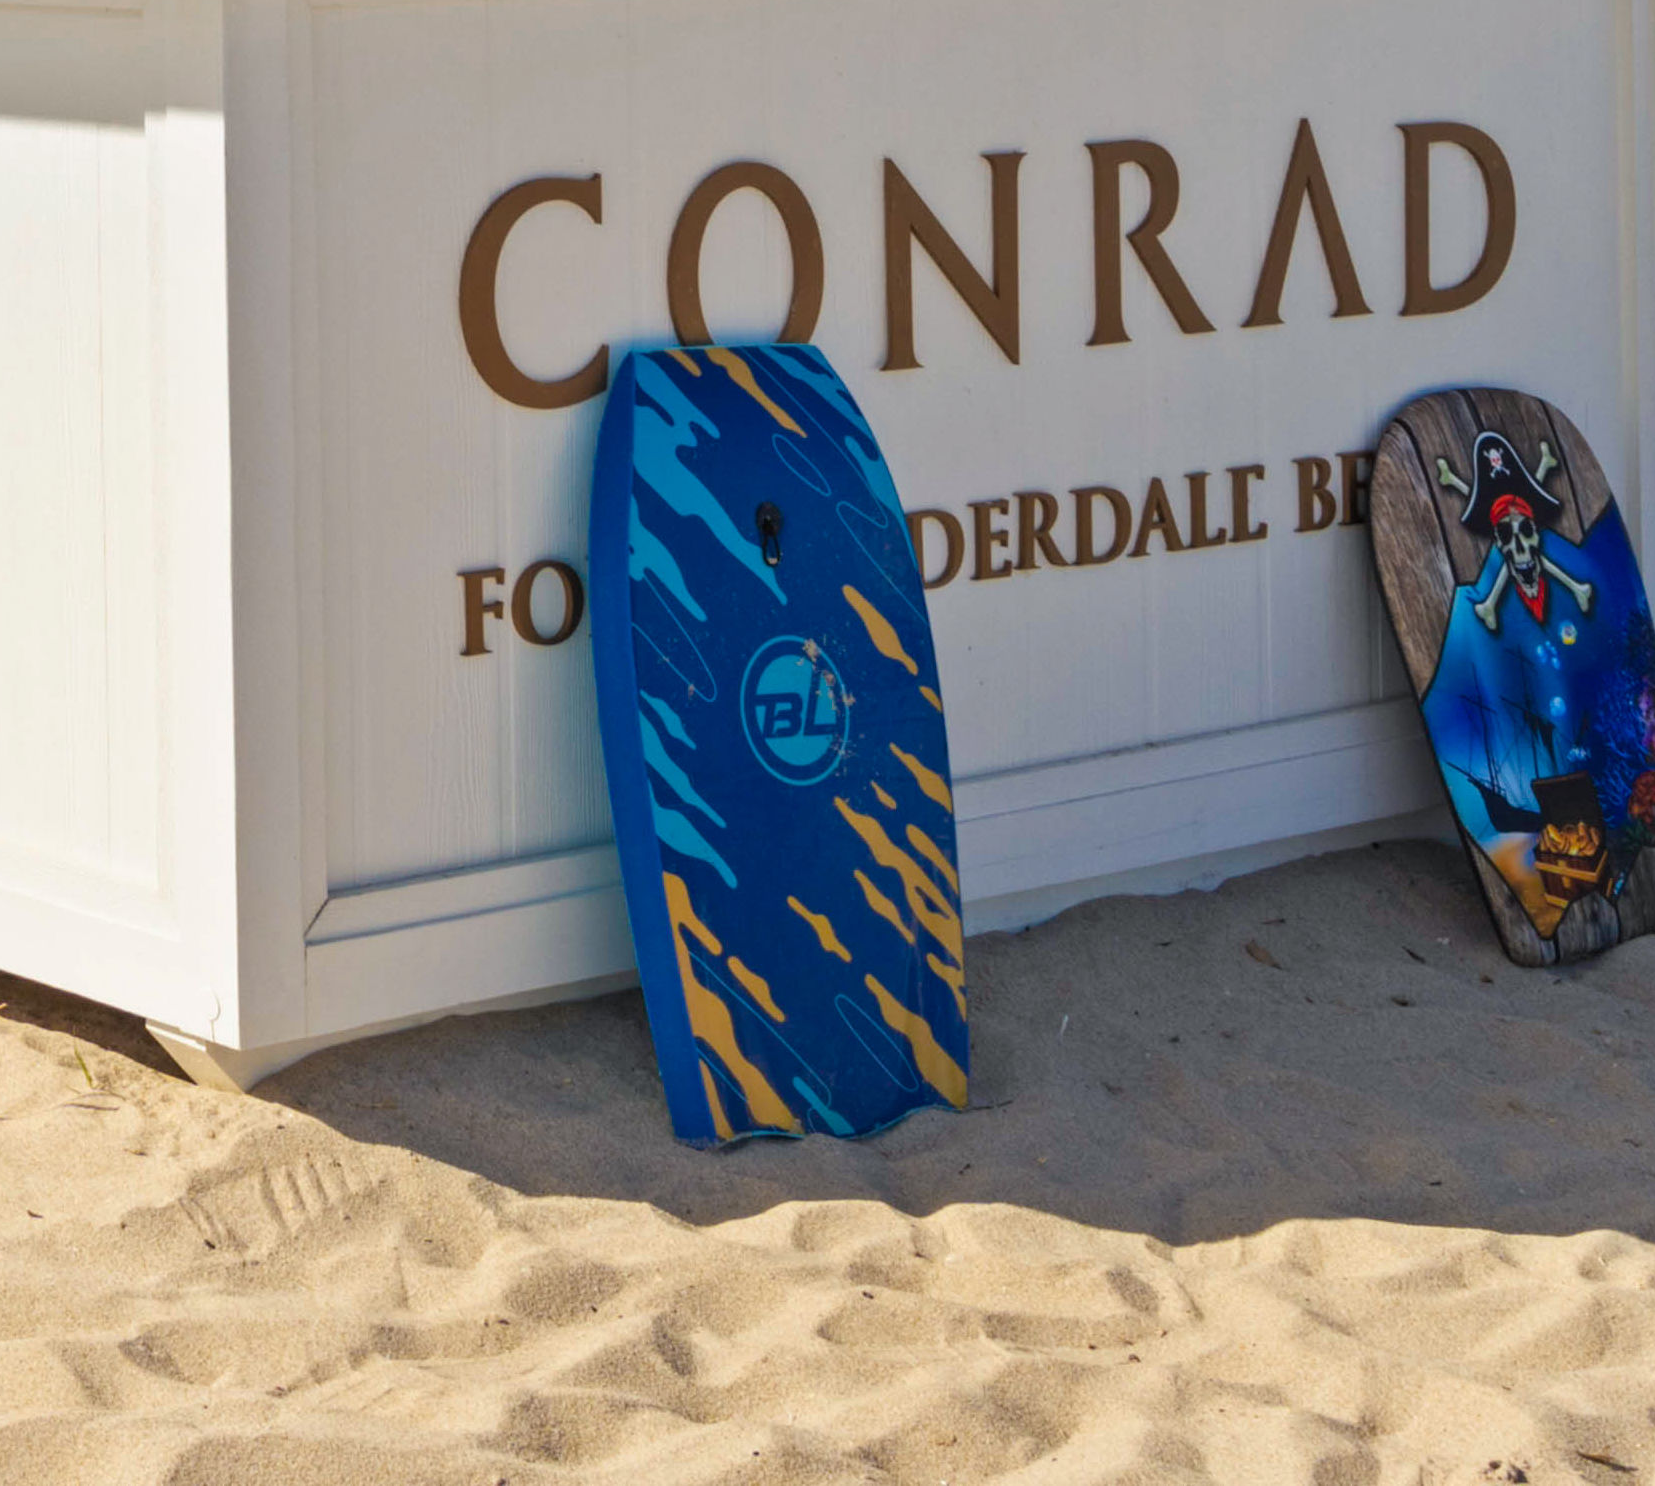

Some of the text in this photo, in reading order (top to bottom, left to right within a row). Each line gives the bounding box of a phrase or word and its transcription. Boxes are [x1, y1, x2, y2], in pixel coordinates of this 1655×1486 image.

[458, 117, 1518, 410] CONRAD
[456, 450, 1374, 657] FO DERDALE BE
[754, 662, 837, 739] BL
